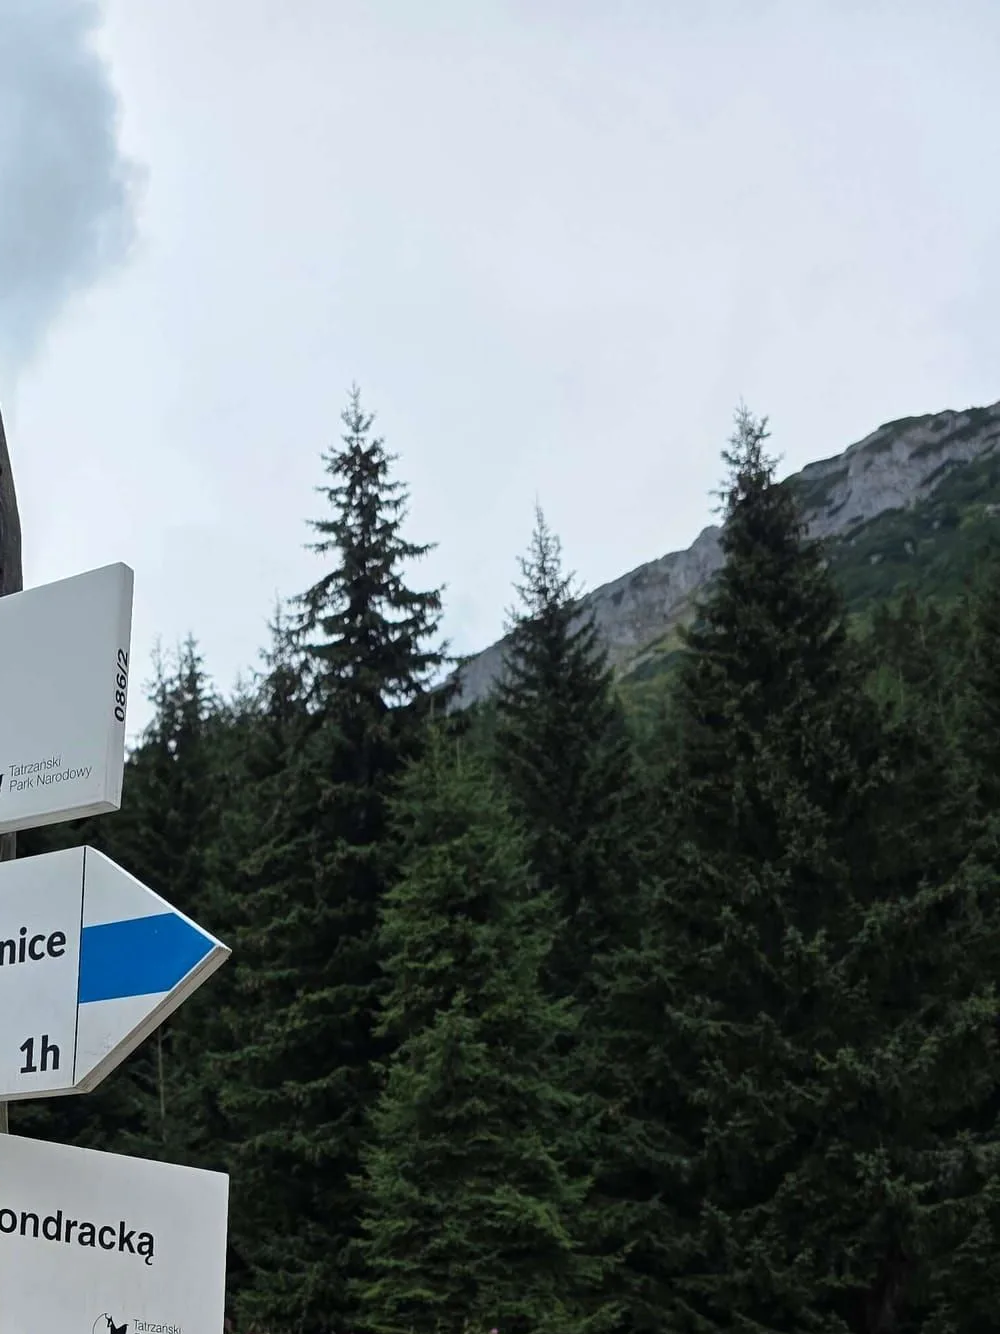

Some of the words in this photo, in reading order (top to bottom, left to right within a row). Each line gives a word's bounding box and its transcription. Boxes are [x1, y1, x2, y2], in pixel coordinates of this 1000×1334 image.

[114, 648, 128, 722] 086/2
[8, 755, 61, 777] Tatrzański
[9, 777, 34, 792] Park
[36, 766, 92, 788] Narodowy
[20, 1035, 60, 1073] 1h
[133, 1318, 182, 1334] Tatrzański
